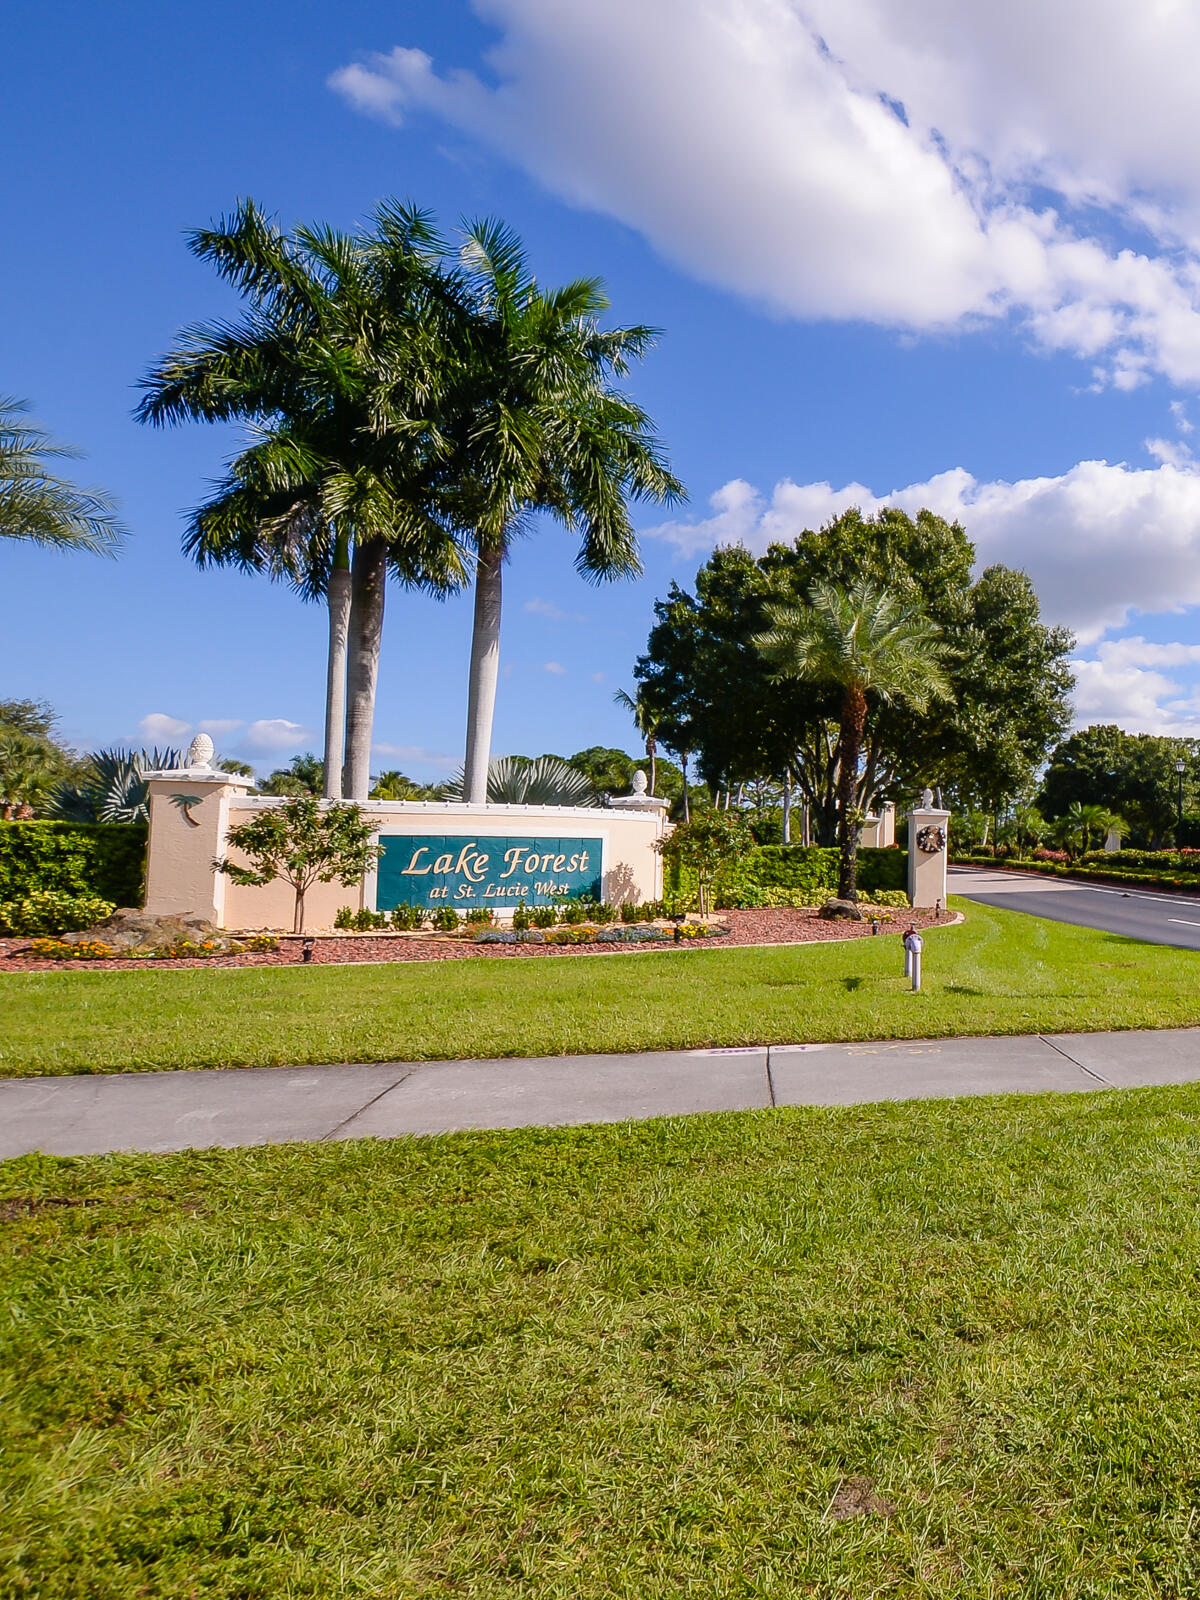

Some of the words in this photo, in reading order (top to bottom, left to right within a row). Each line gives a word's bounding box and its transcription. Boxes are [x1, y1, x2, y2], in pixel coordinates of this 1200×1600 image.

[401, 842, 490, 883] Lake
[499, 847, 590, 879] Forest
[429, 884, 449, 899] at
[453, 883, 477, 900] St.
[482, 881, 529, 898] Lucie
[534, 880, 570, 896] West
